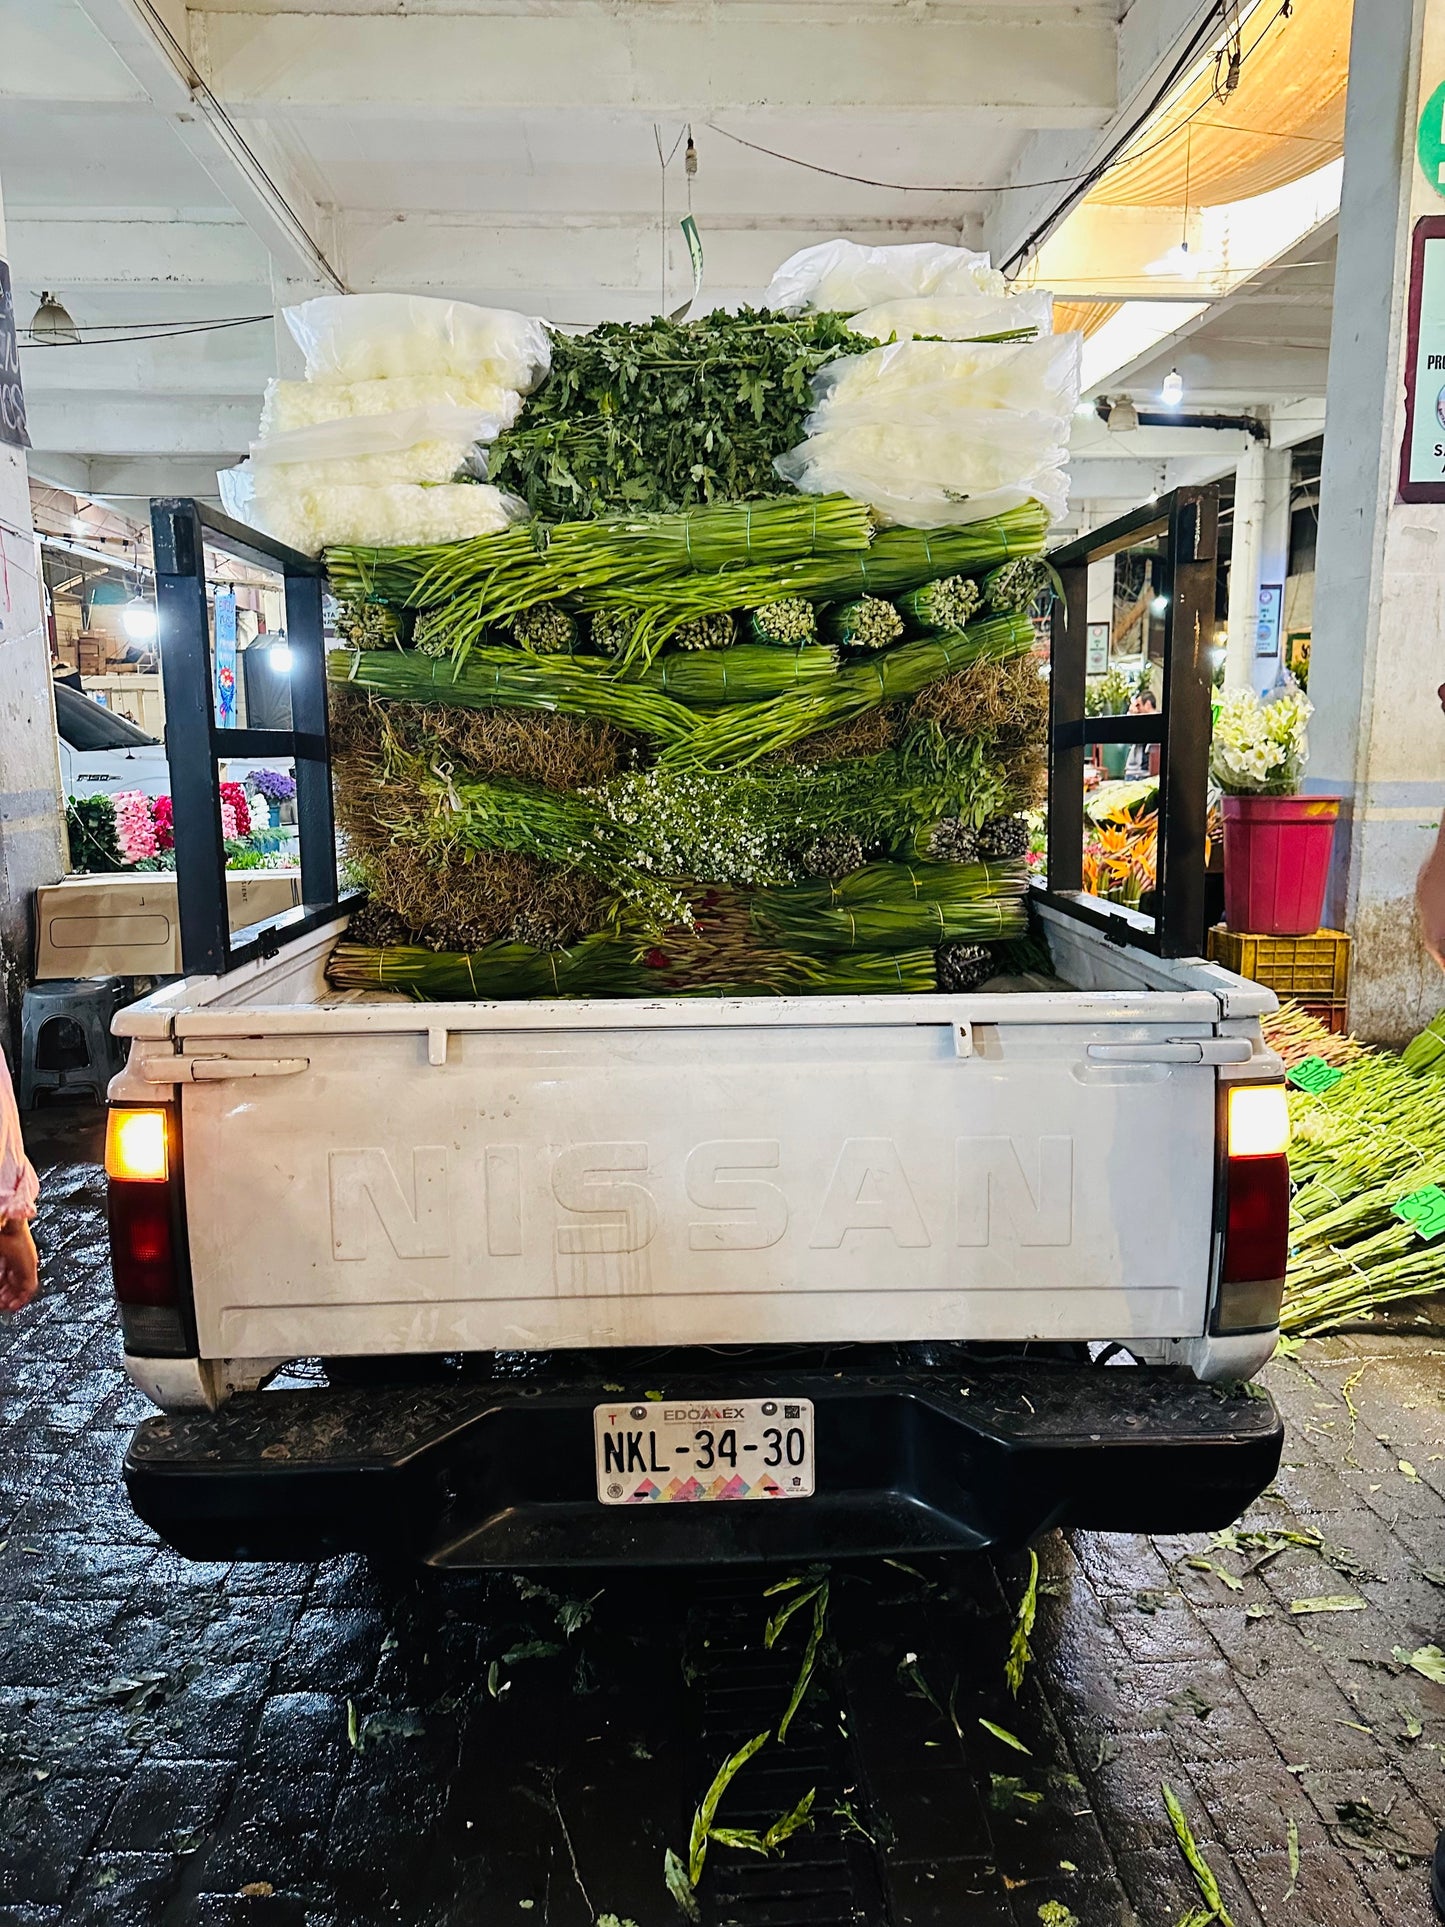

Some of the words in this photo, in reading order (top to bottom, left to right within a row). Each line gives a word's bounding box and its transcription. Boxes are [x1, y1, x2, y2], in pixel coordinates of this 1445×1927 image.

[1434, 444, 1445, 457] S
[328, 1135, 1074, 1261] NISSAN
[608, 1414, 617, 1426] T
[603, 1427, 805, 1474] NKL-34-30
